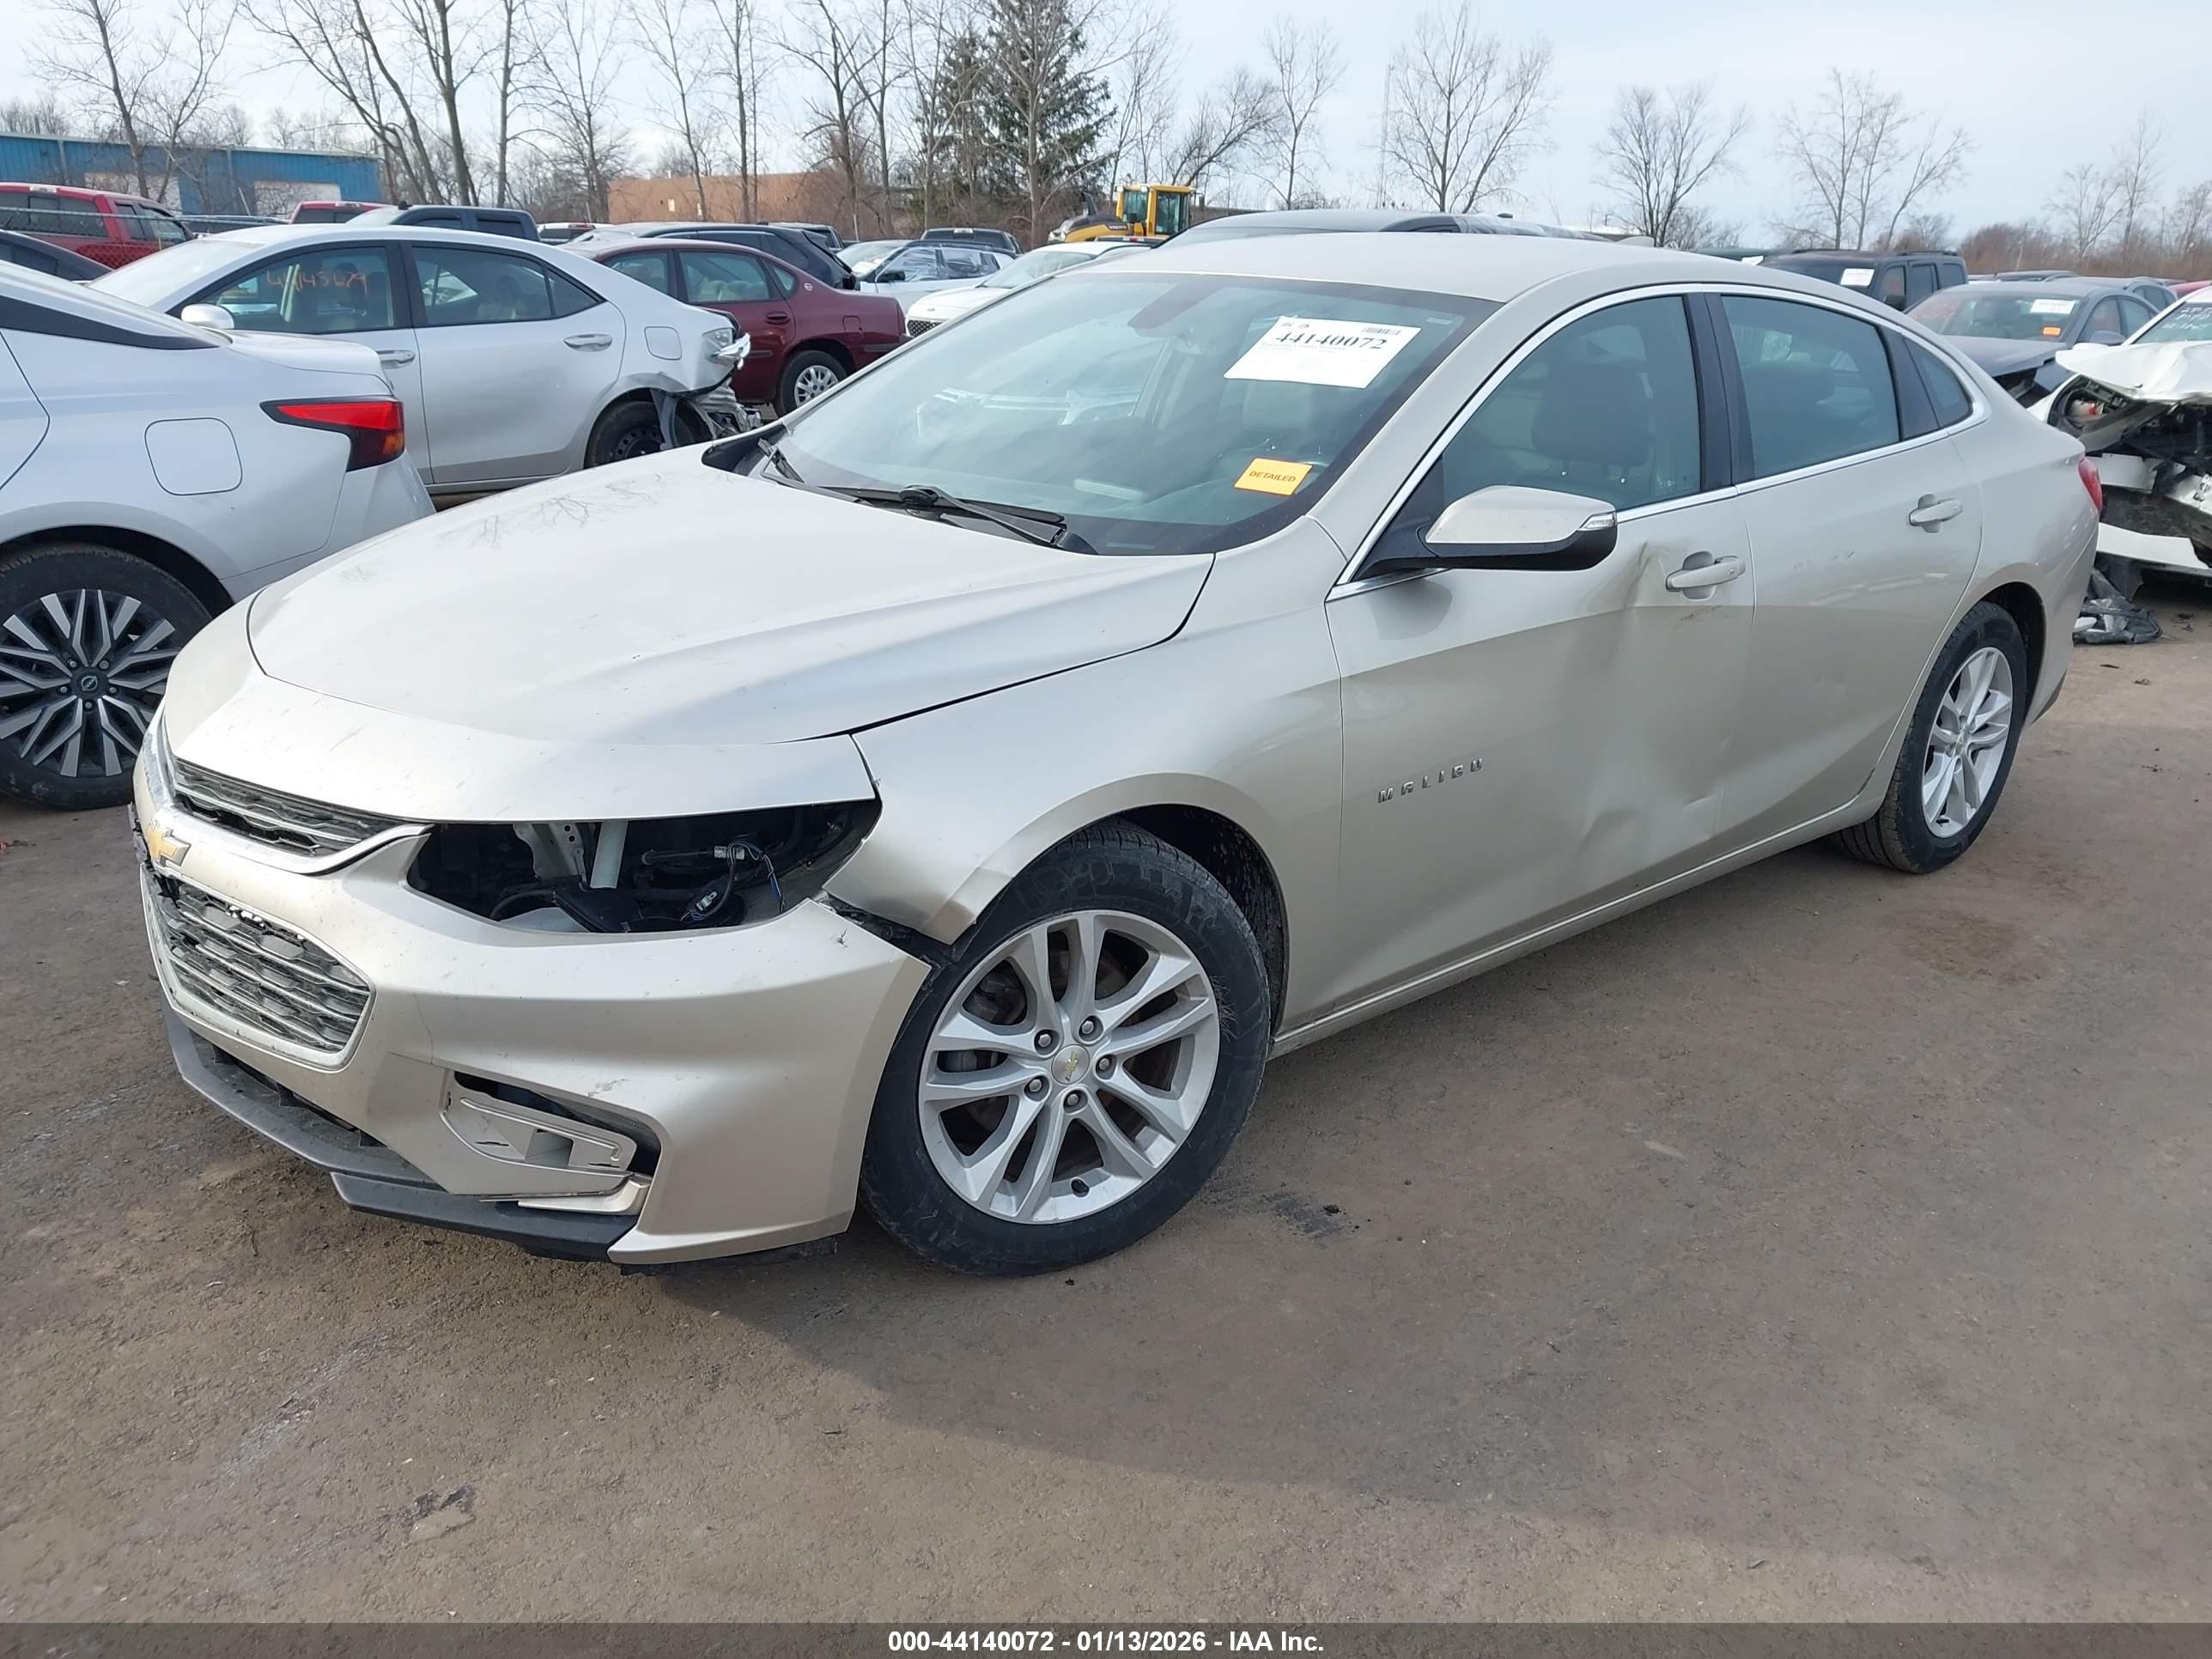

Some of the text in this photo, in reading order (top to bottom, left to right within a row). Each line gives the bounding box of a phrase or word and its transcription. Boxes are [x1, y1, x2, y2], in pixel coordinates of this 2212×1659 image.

[1275, 331, 1388, 349] 44140072
[1249, 471, 1297, 483] DETAILED
[1377, 757, 1484, 803] MALIBU
